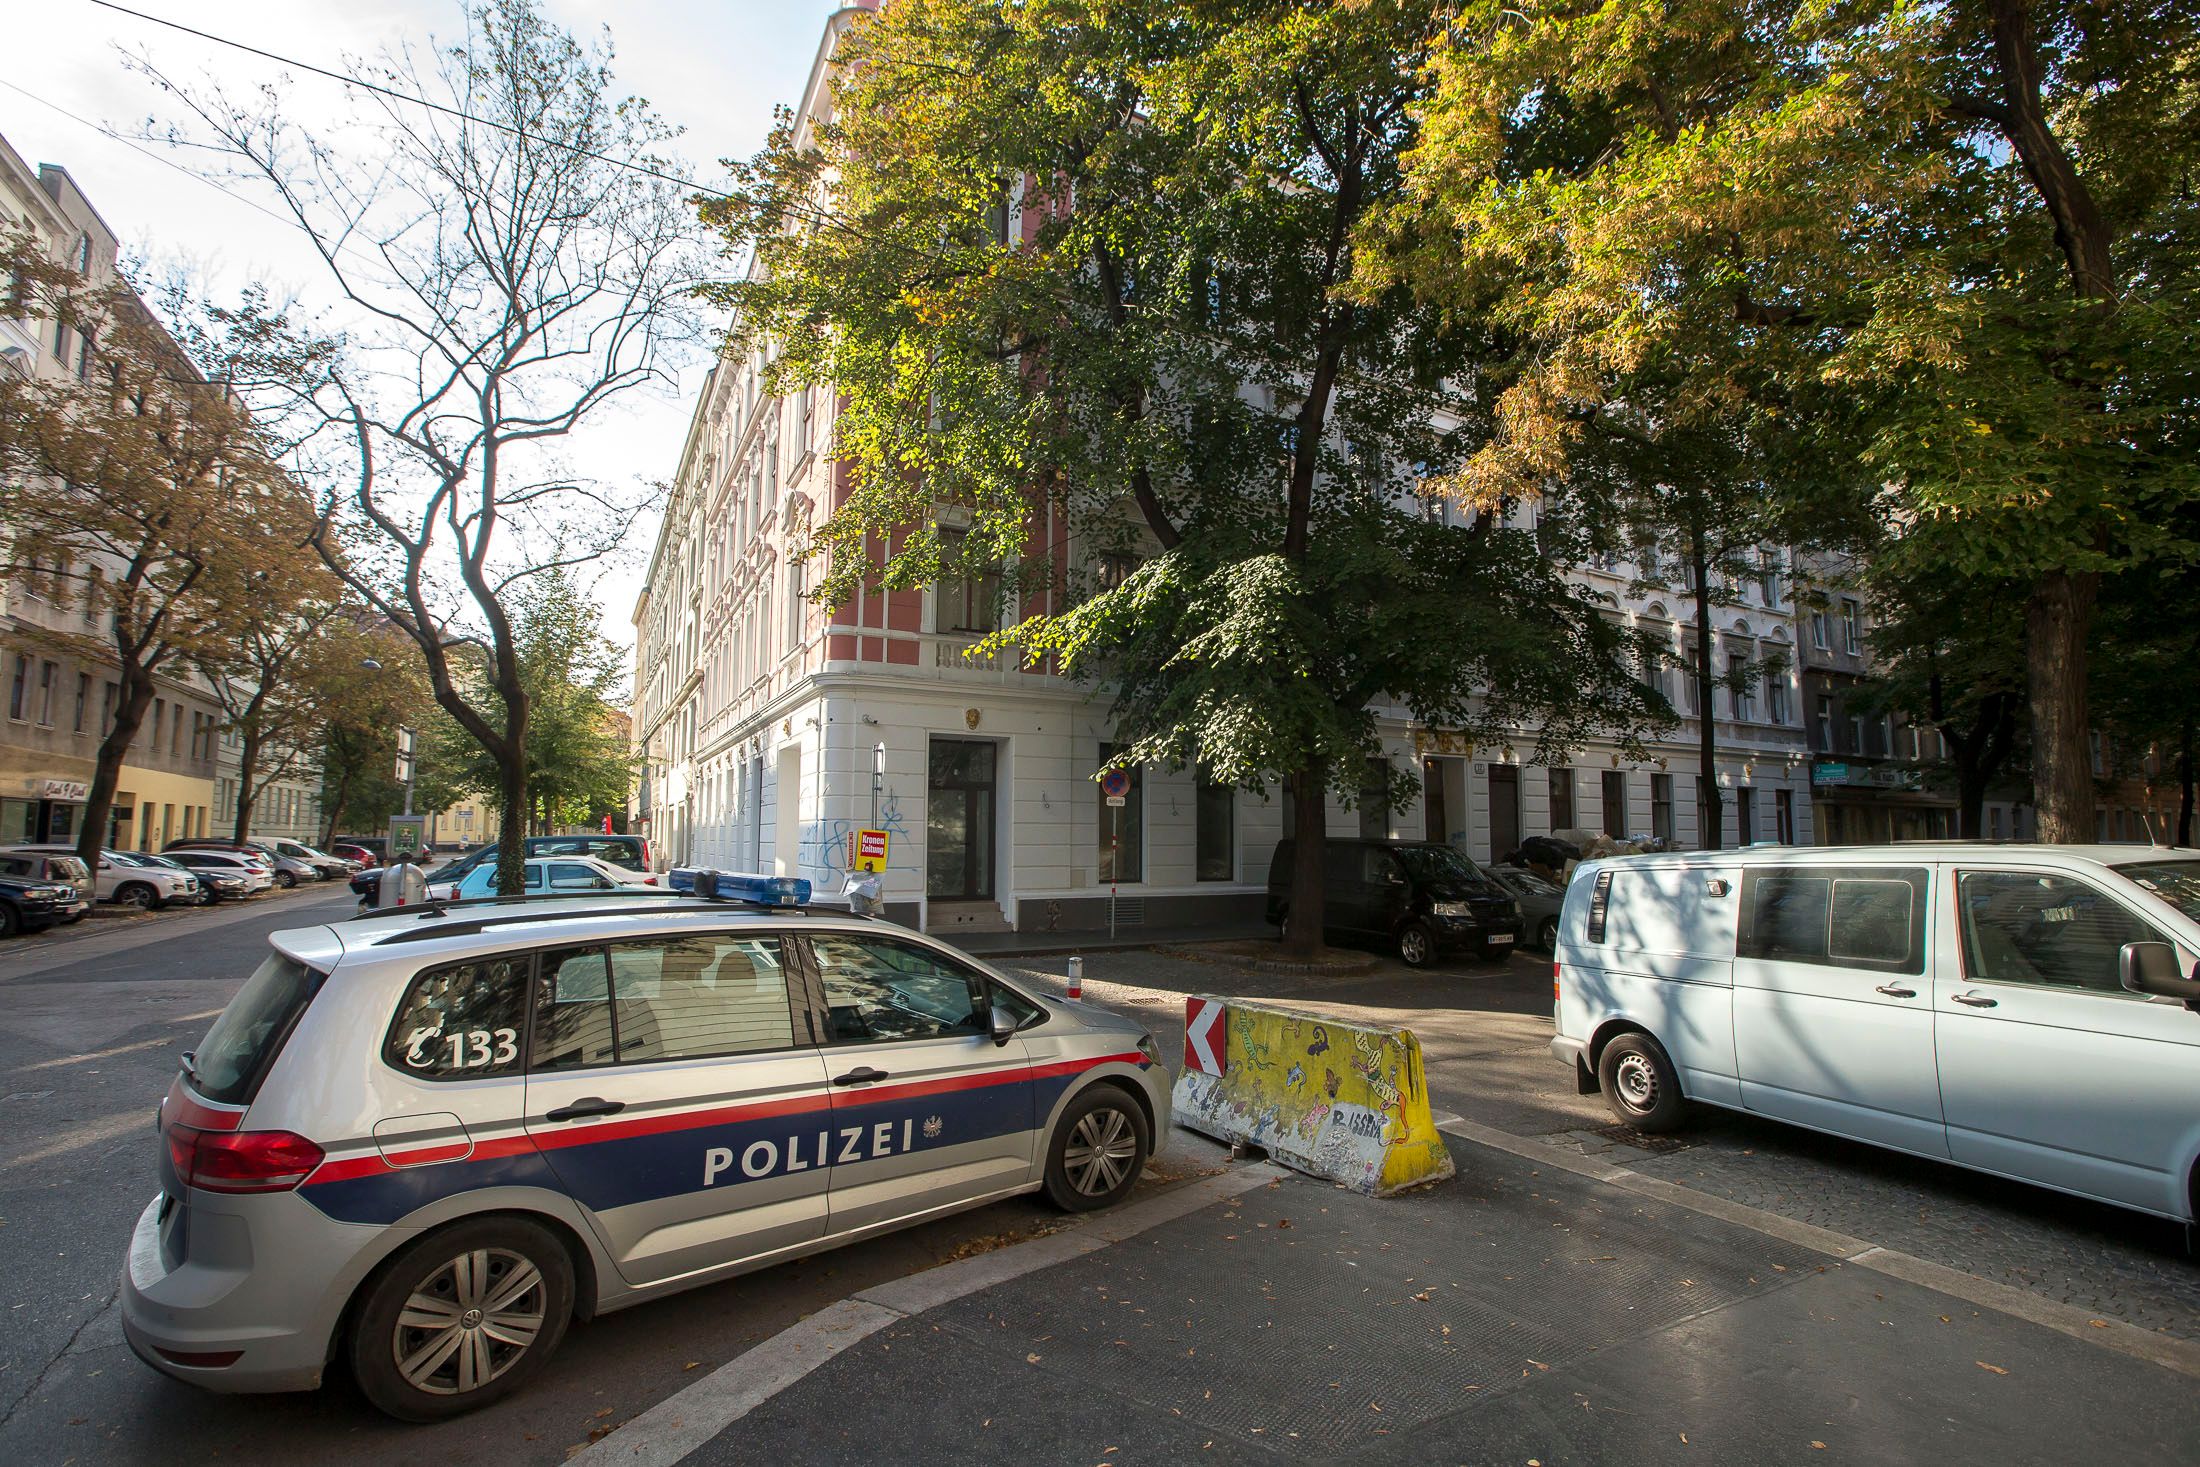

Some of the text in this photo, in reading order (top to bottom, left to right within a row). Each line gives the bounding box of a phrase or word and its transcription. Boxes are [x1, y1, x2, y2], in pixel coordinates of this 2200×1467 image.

[861, 844, 884, 856] Zeitung
[862, 834, 885, 845] Kronen
[445, 1027, 518, 1068] 133
[703, 1118, 913, 1186] POLIZEI
